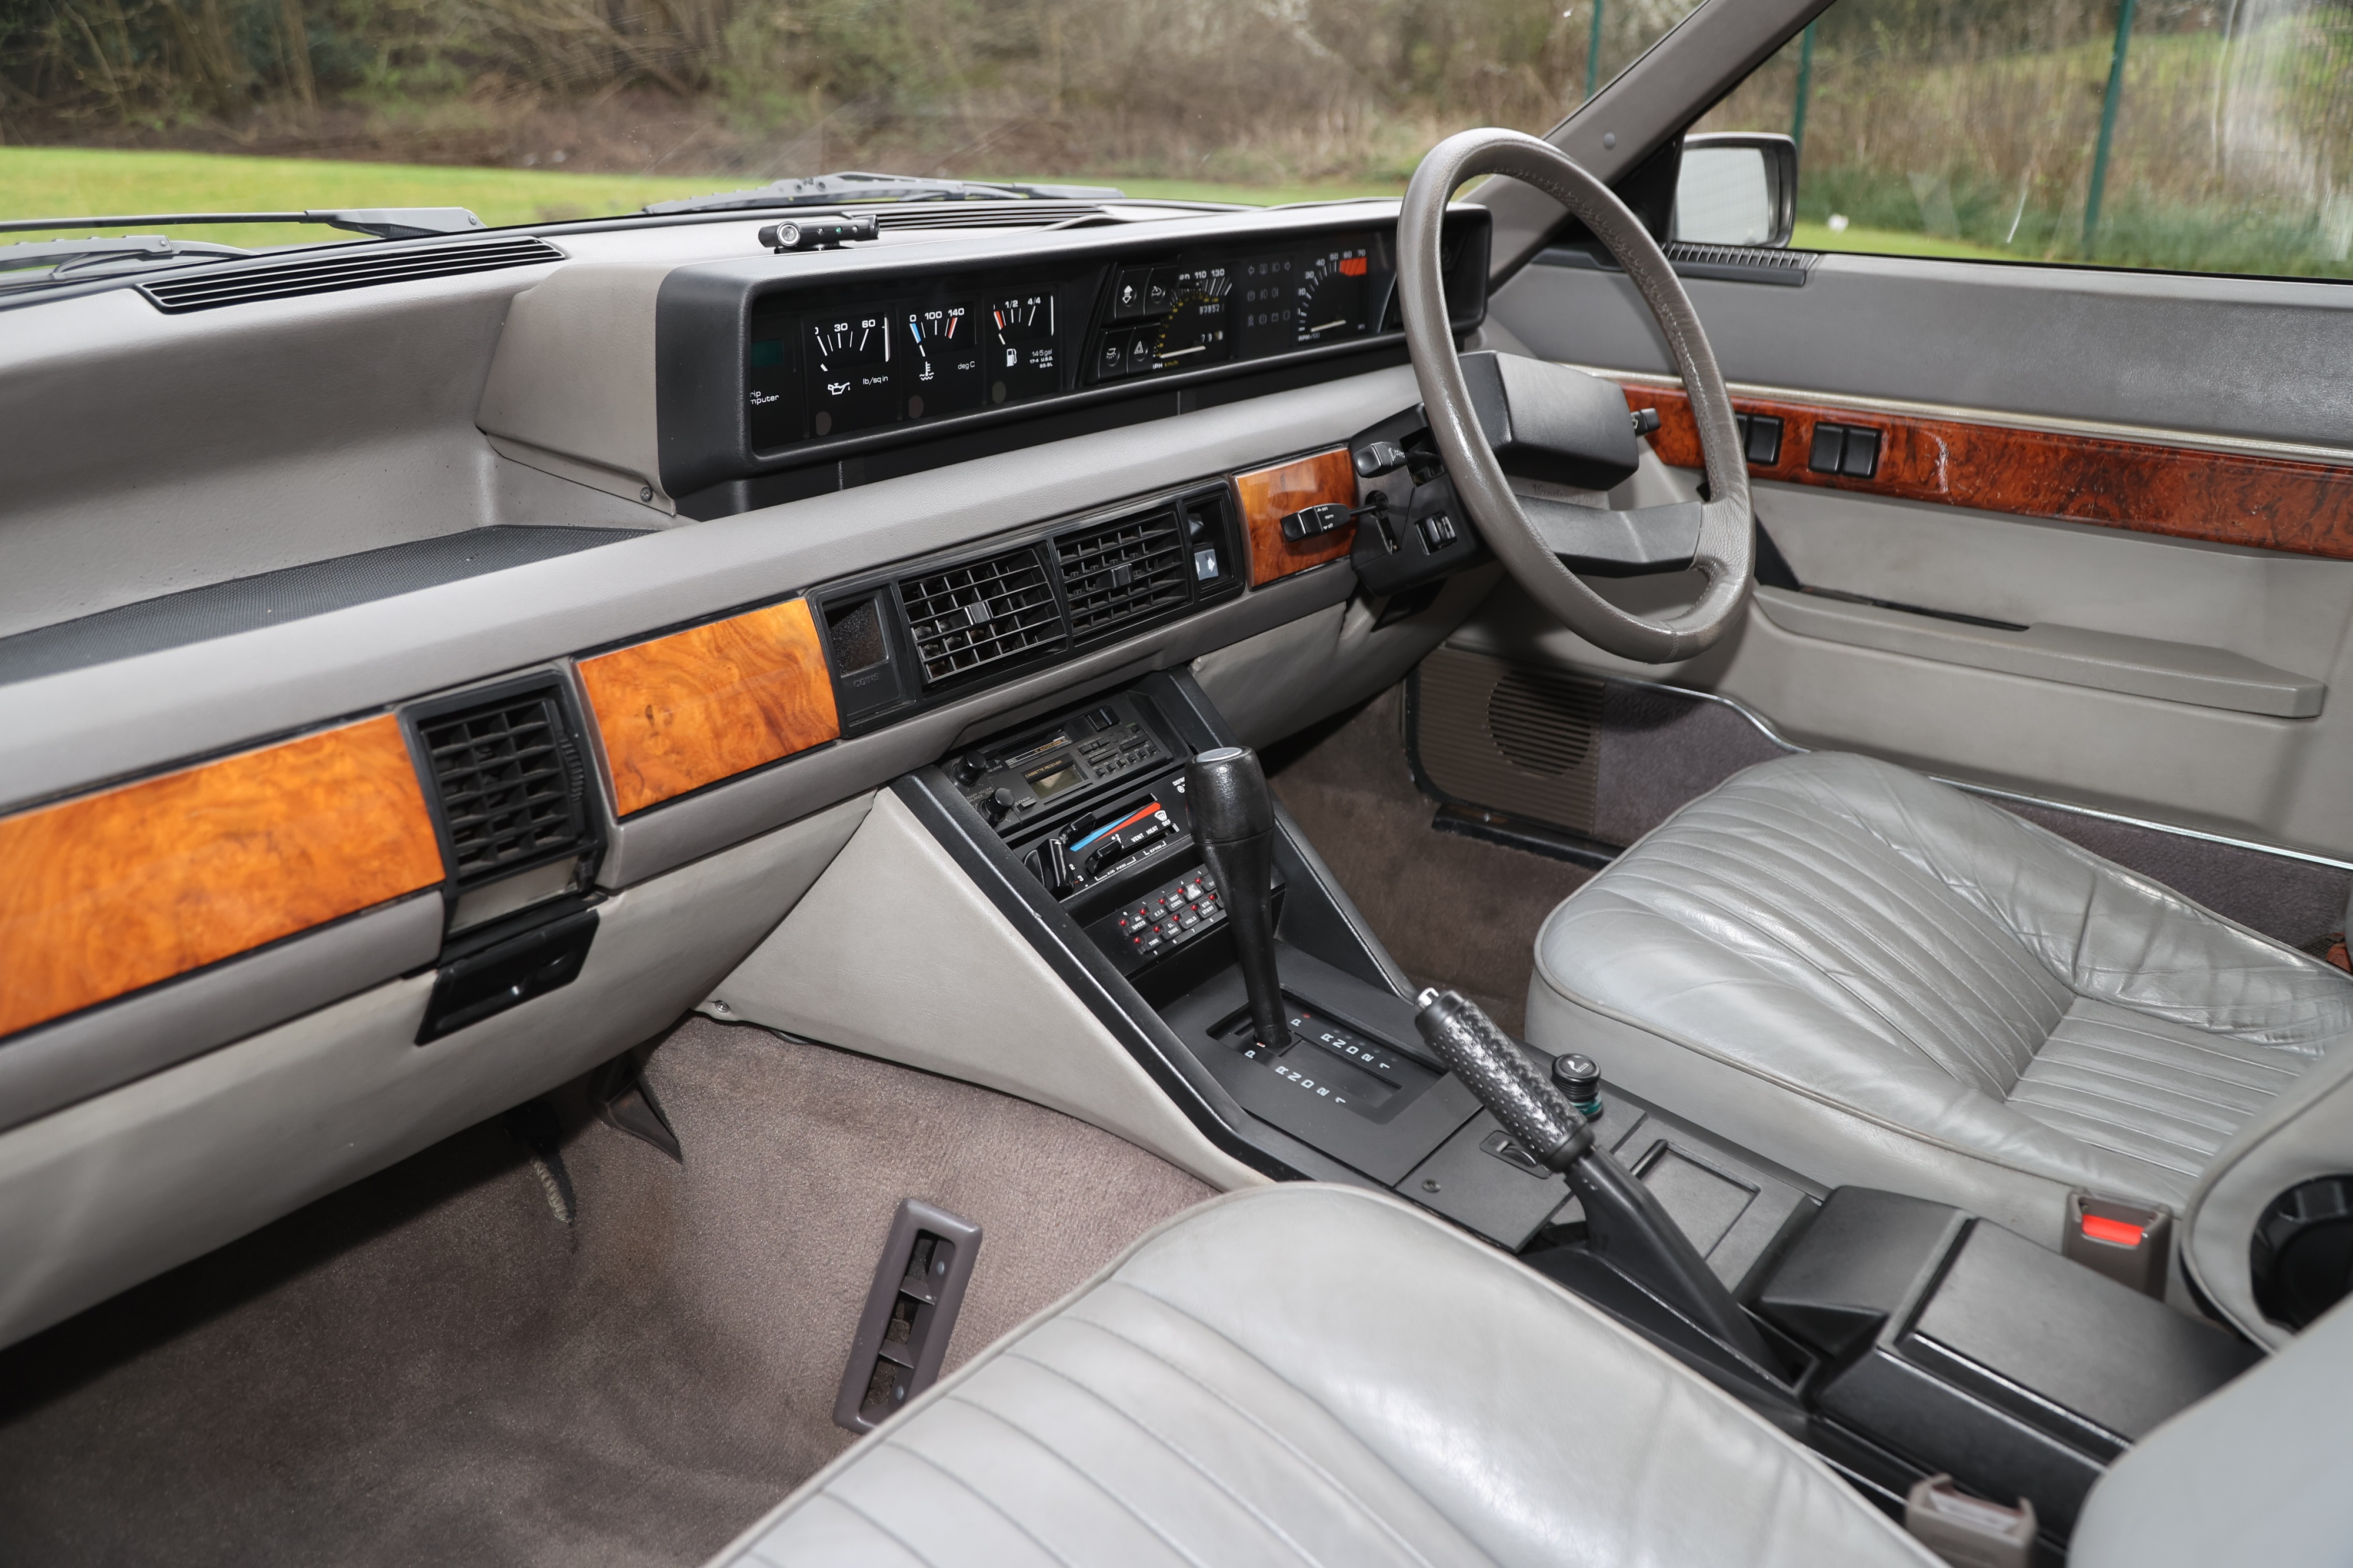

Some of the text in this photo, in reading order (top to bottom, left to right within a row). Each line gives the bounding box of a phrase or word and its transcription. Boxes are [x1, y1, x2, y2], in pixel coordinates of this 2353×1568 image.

[1195, 271, 1207, 279] 110
[1211, 268, 1225, 277] 130
[1005, 300, 1018, 309] 1/2
[1027, 296, 1041, 305] 4/4
[925, 311, 942, 320] 100
[948, 308, 965, 317] 140
[834, 323, 848, 332] 30
[862, 319, 876, 328] 60
[854, 673, 880, 688] COINS
[1025, 760, 1062, 778] CASSETTE RECEIVER
[1161, 819, 1171, 827] DEF
[1146, 825, 1159, 835] HEAT
[1131, 833, 1145, 843] VENT
[1169, 894, 1179, 902] INST
[1171, 900, 1184, 908] CONS.
[1201, 905, 1214, 915] START
[1132, 920, 1146, 930] SPEED
[1185, 916, 1197, 925] HOLD
[1148, 938, 1159, 946] TIME
[1291, 1018, 1302, 1027] P
[1320, 1033, 1334, 1042] R
[1332, 1039, 1346, 1048] N
[1346, 1046, 1359, 1055] D
[1361, 1053, 1375, 1063] 2
[1245, 1049, 1256, 1059] P
[1275, 1066, 1289, 1075] R
[1287, 1072, 1302, 1082] N
[1301, 1079, 1315, 1089] D
[1316, 1087, 1330, 1097] 2
